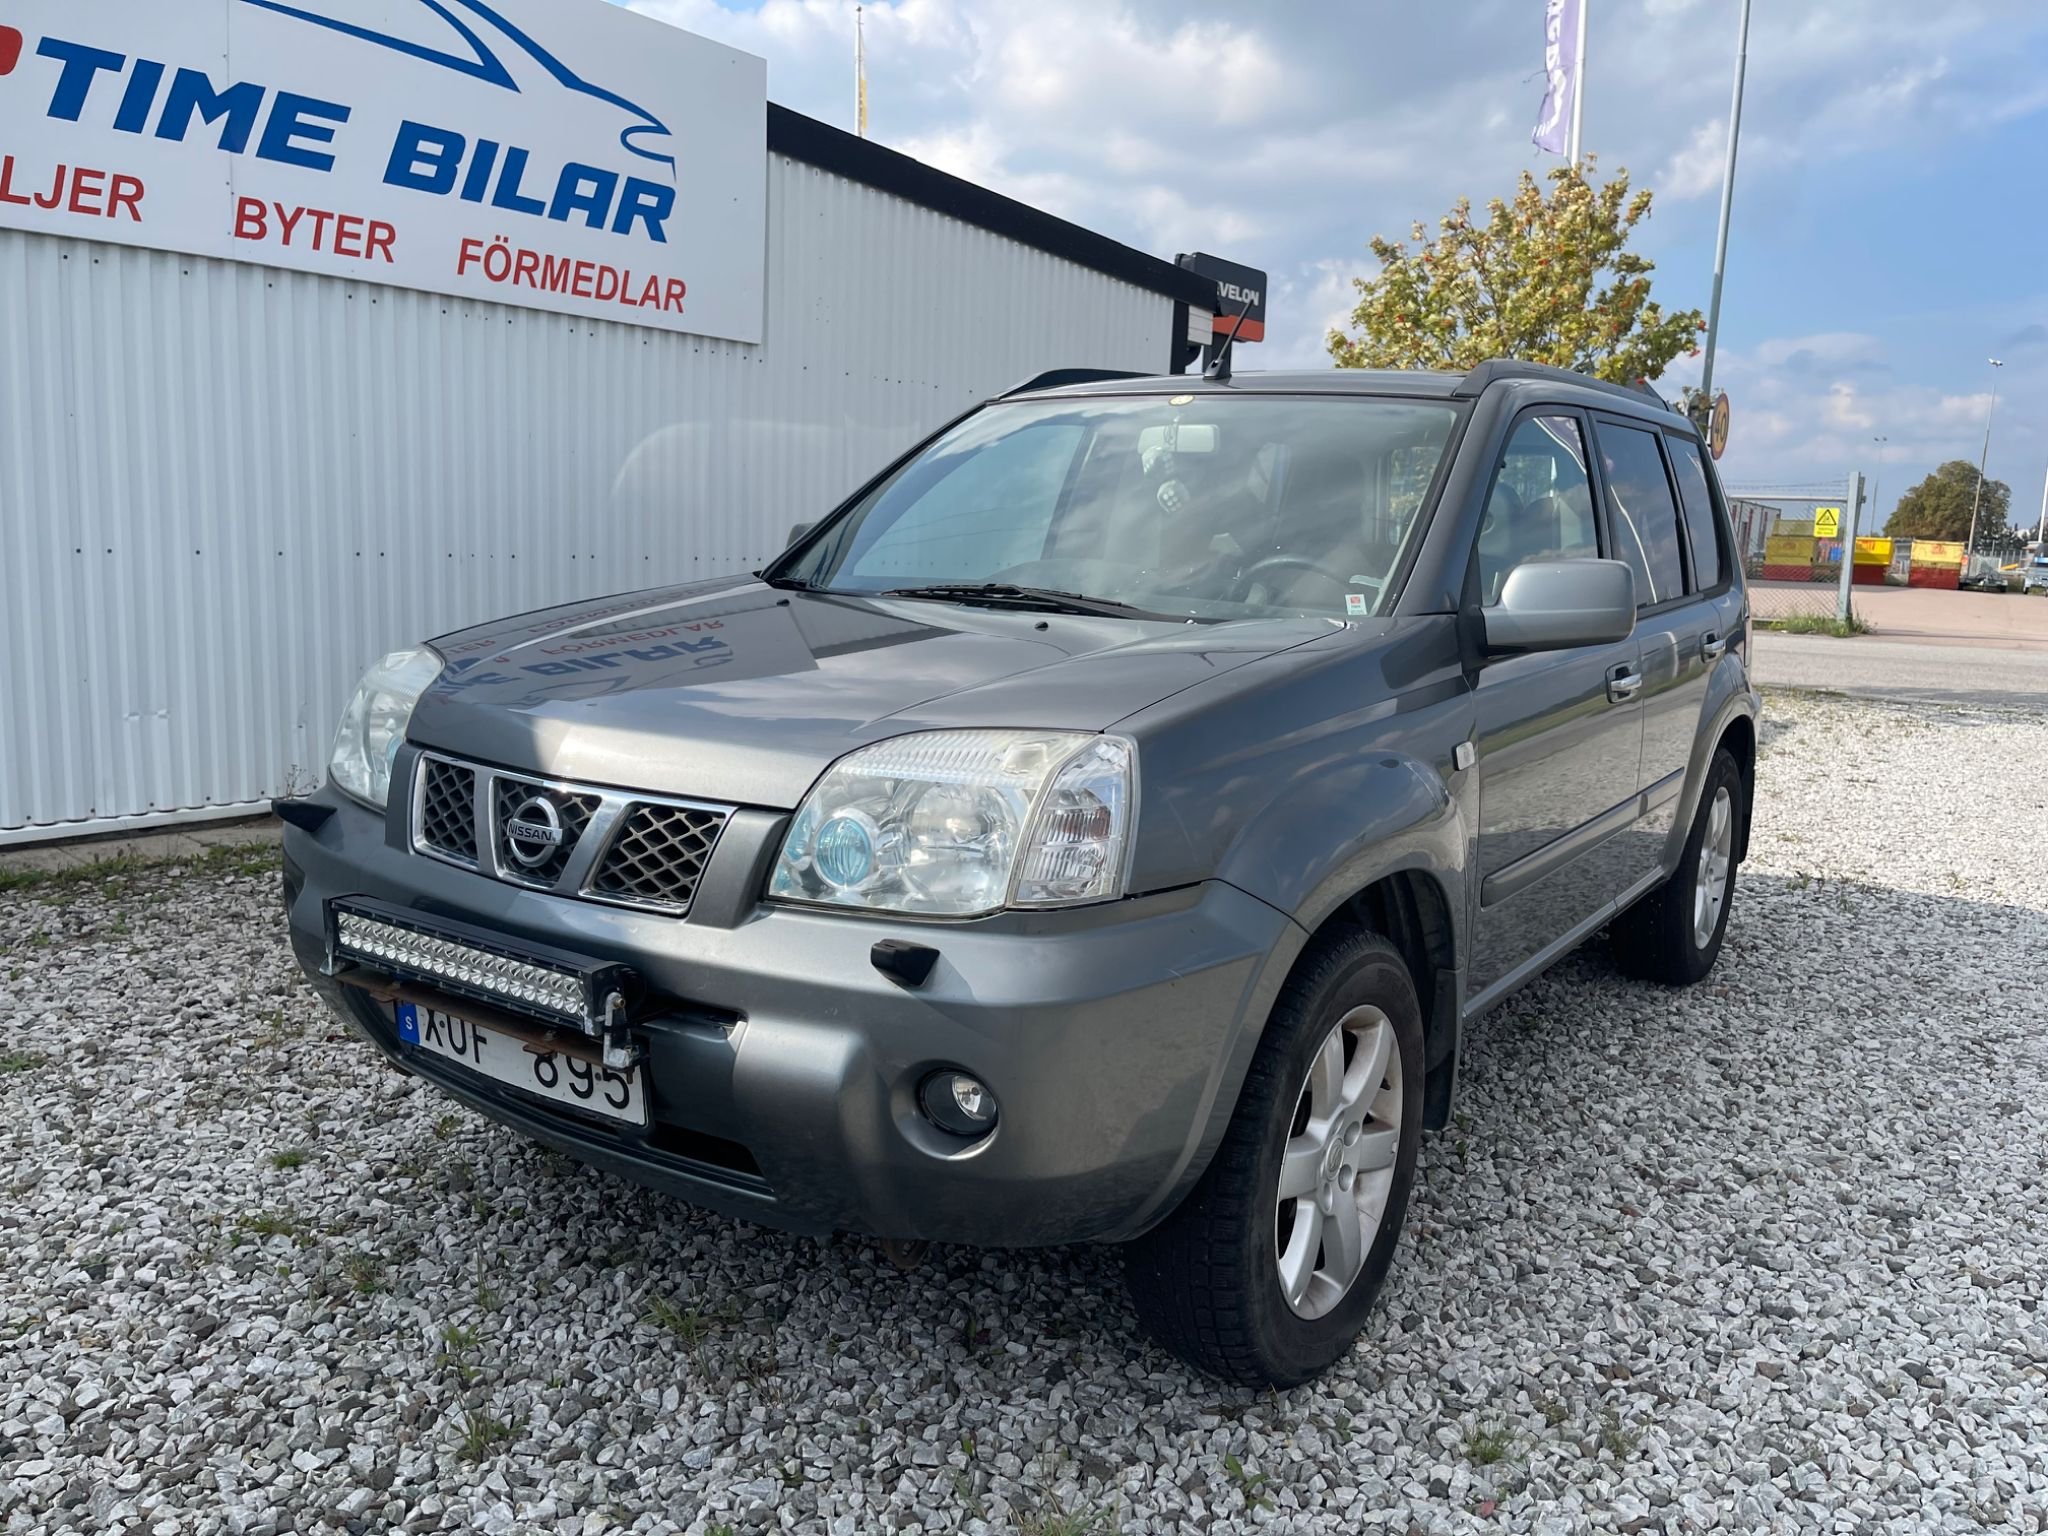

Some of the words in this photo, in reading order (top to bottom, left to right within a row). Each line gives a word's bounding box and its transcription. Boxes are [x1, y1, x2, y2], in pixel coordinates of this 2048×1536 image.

[36, 36, 352, 172] TIME
[382, 119, 676, 244] BILAR
[0, 155, 145, 222] LJER
[234, 196, 397, 263] BYTER
[456, 234, 687, 314] FÖRMEDLAR
[1217, 281, 1259, 306] VELON
[509, 823, 552, 841] NISSAN
[404, 1015, 414, 1031] S
